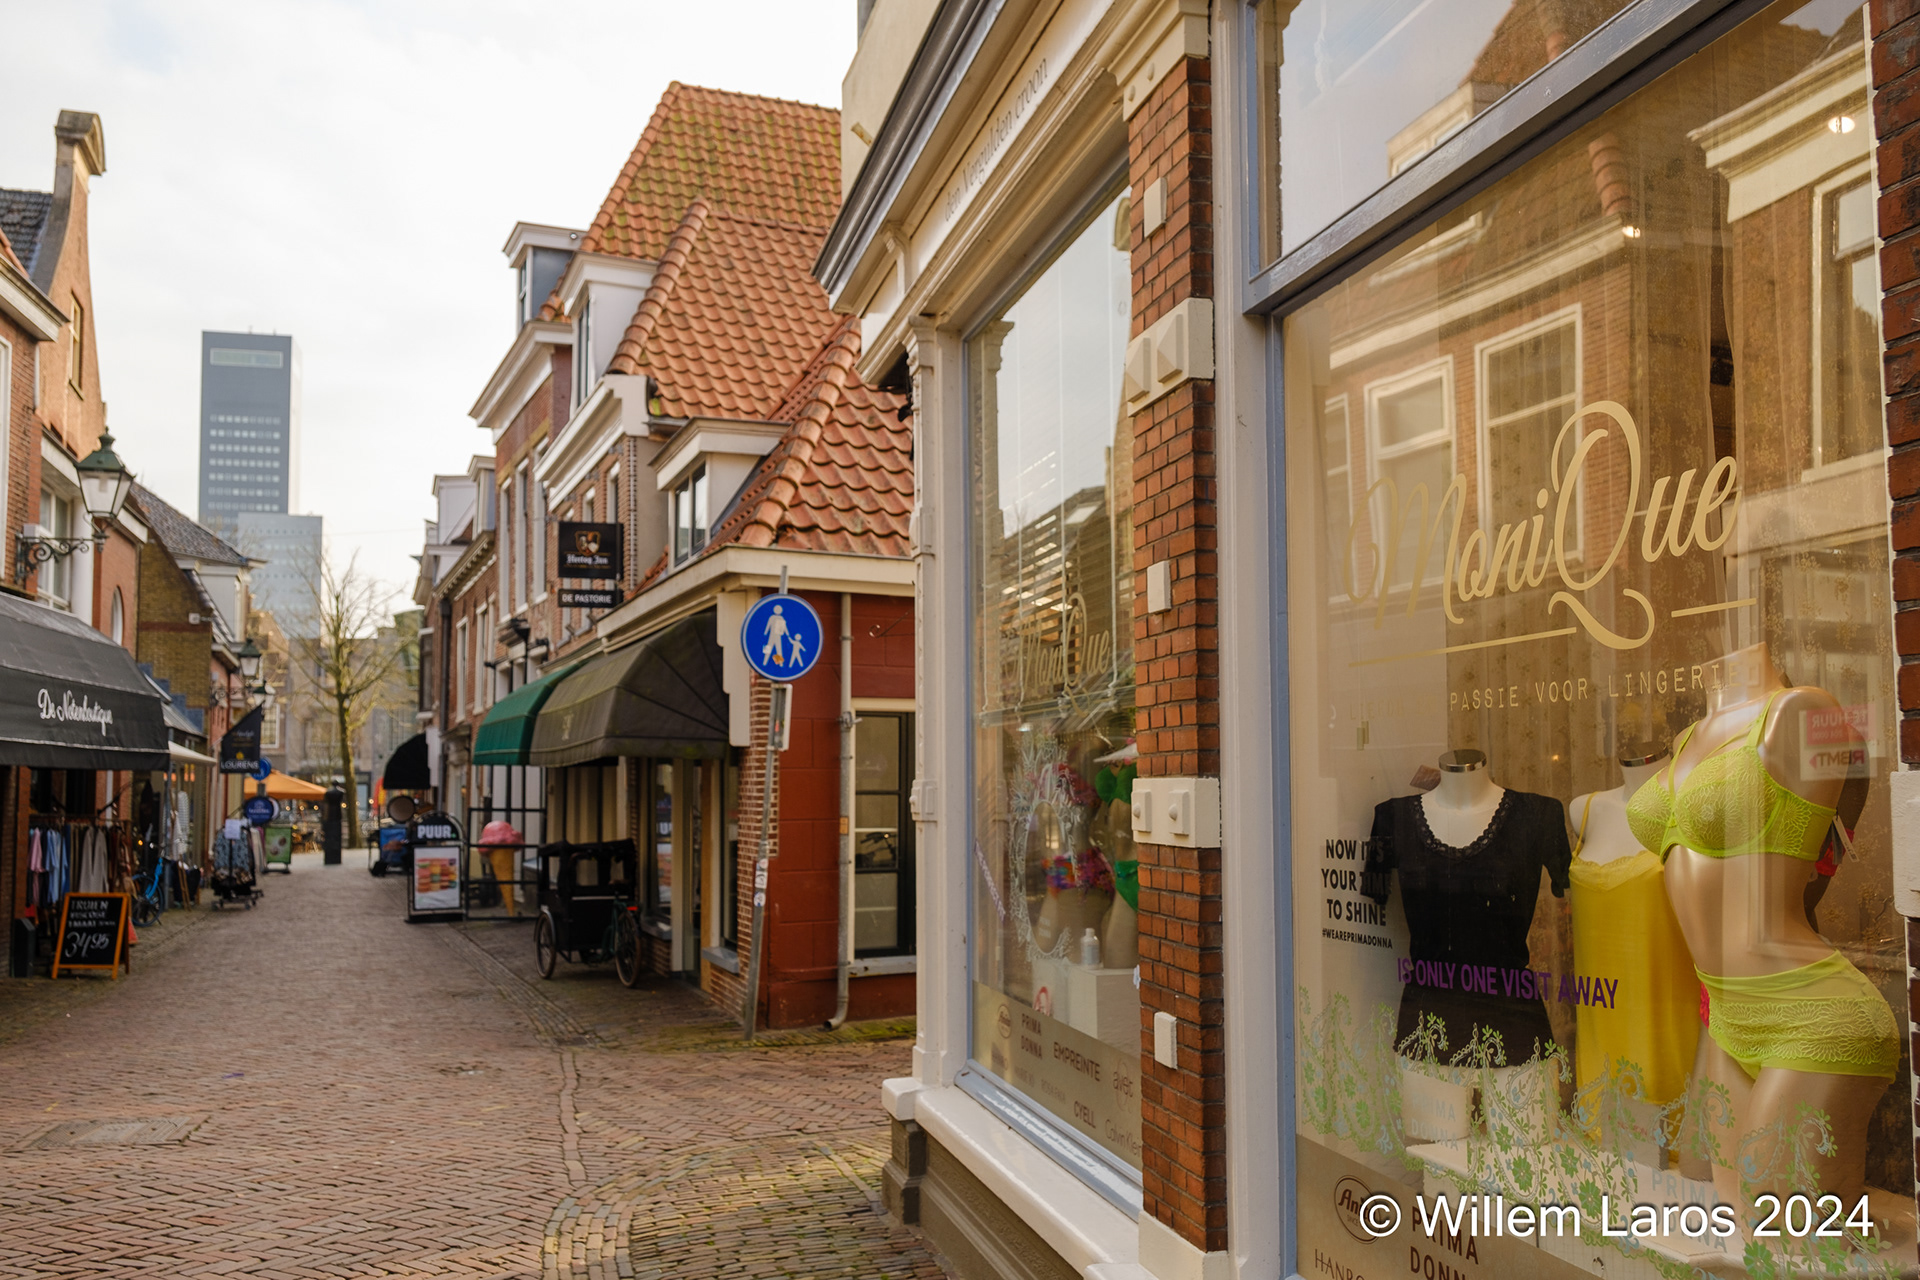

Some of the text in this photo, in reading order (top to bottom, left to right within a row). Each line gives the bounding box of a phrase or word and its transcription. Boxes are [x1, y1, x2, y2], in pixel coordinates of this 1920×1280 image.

[1015, 58, 1048, 119] croon
[1343, 400, 1742, 650] MoniQue
[562, 593, 612, 603] DE PASTORIE
[1450, 686, 1519, 712] PASSIE
[1535, 679, 1589, 704] VOOR
[1608, 663, 1742, 698] LINGERIE
[220, 760, 259, 770] LOURENS
[1326, 839, 1357, 860] NOW
[1321, 868, 1392, 895] YOUR TIME
[1326, 898, 1387, 927] TO SHINE
[1322, 927, 1393, 950] #WEAREPRIMADONNA
[1397, 957, 1618, 1009] IS ONLY ONE VISIT AWAY
[1021, 1012, 1042, 1037] PRIMA
[1021, 1035, 1043, 1060] DONNA
[1053, 1041, 1101, 1082] EMPREINTE
[1074, 1100, 1097, 1129] CYELL
[1314, 1248, 1365, 1280] HANR
